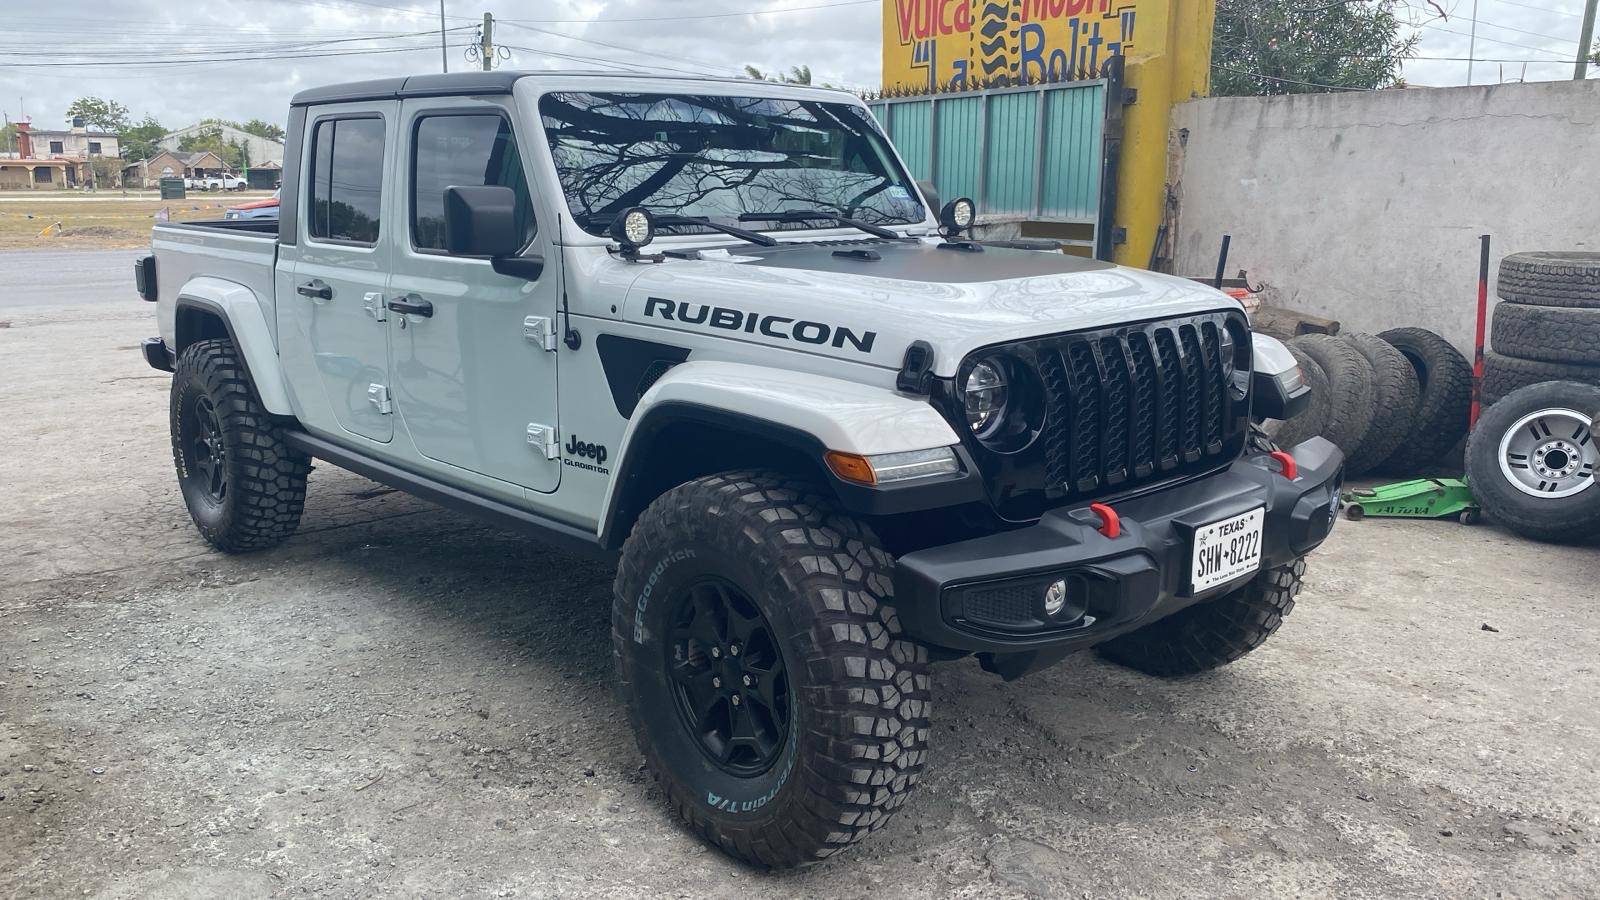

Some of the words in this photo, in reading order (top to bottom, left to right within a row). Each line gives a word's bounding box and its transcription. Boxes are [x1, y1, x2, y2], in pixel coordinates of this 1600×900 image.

[643, 296, 877, 354] RUBICON
[565, 434, 607, 465] Jeep
[564, 458, 609, 475] GLADIATOR
[1219, 518, 1245, 538] TEXAS
[633, 548, 697, 645] BFGoodrich
